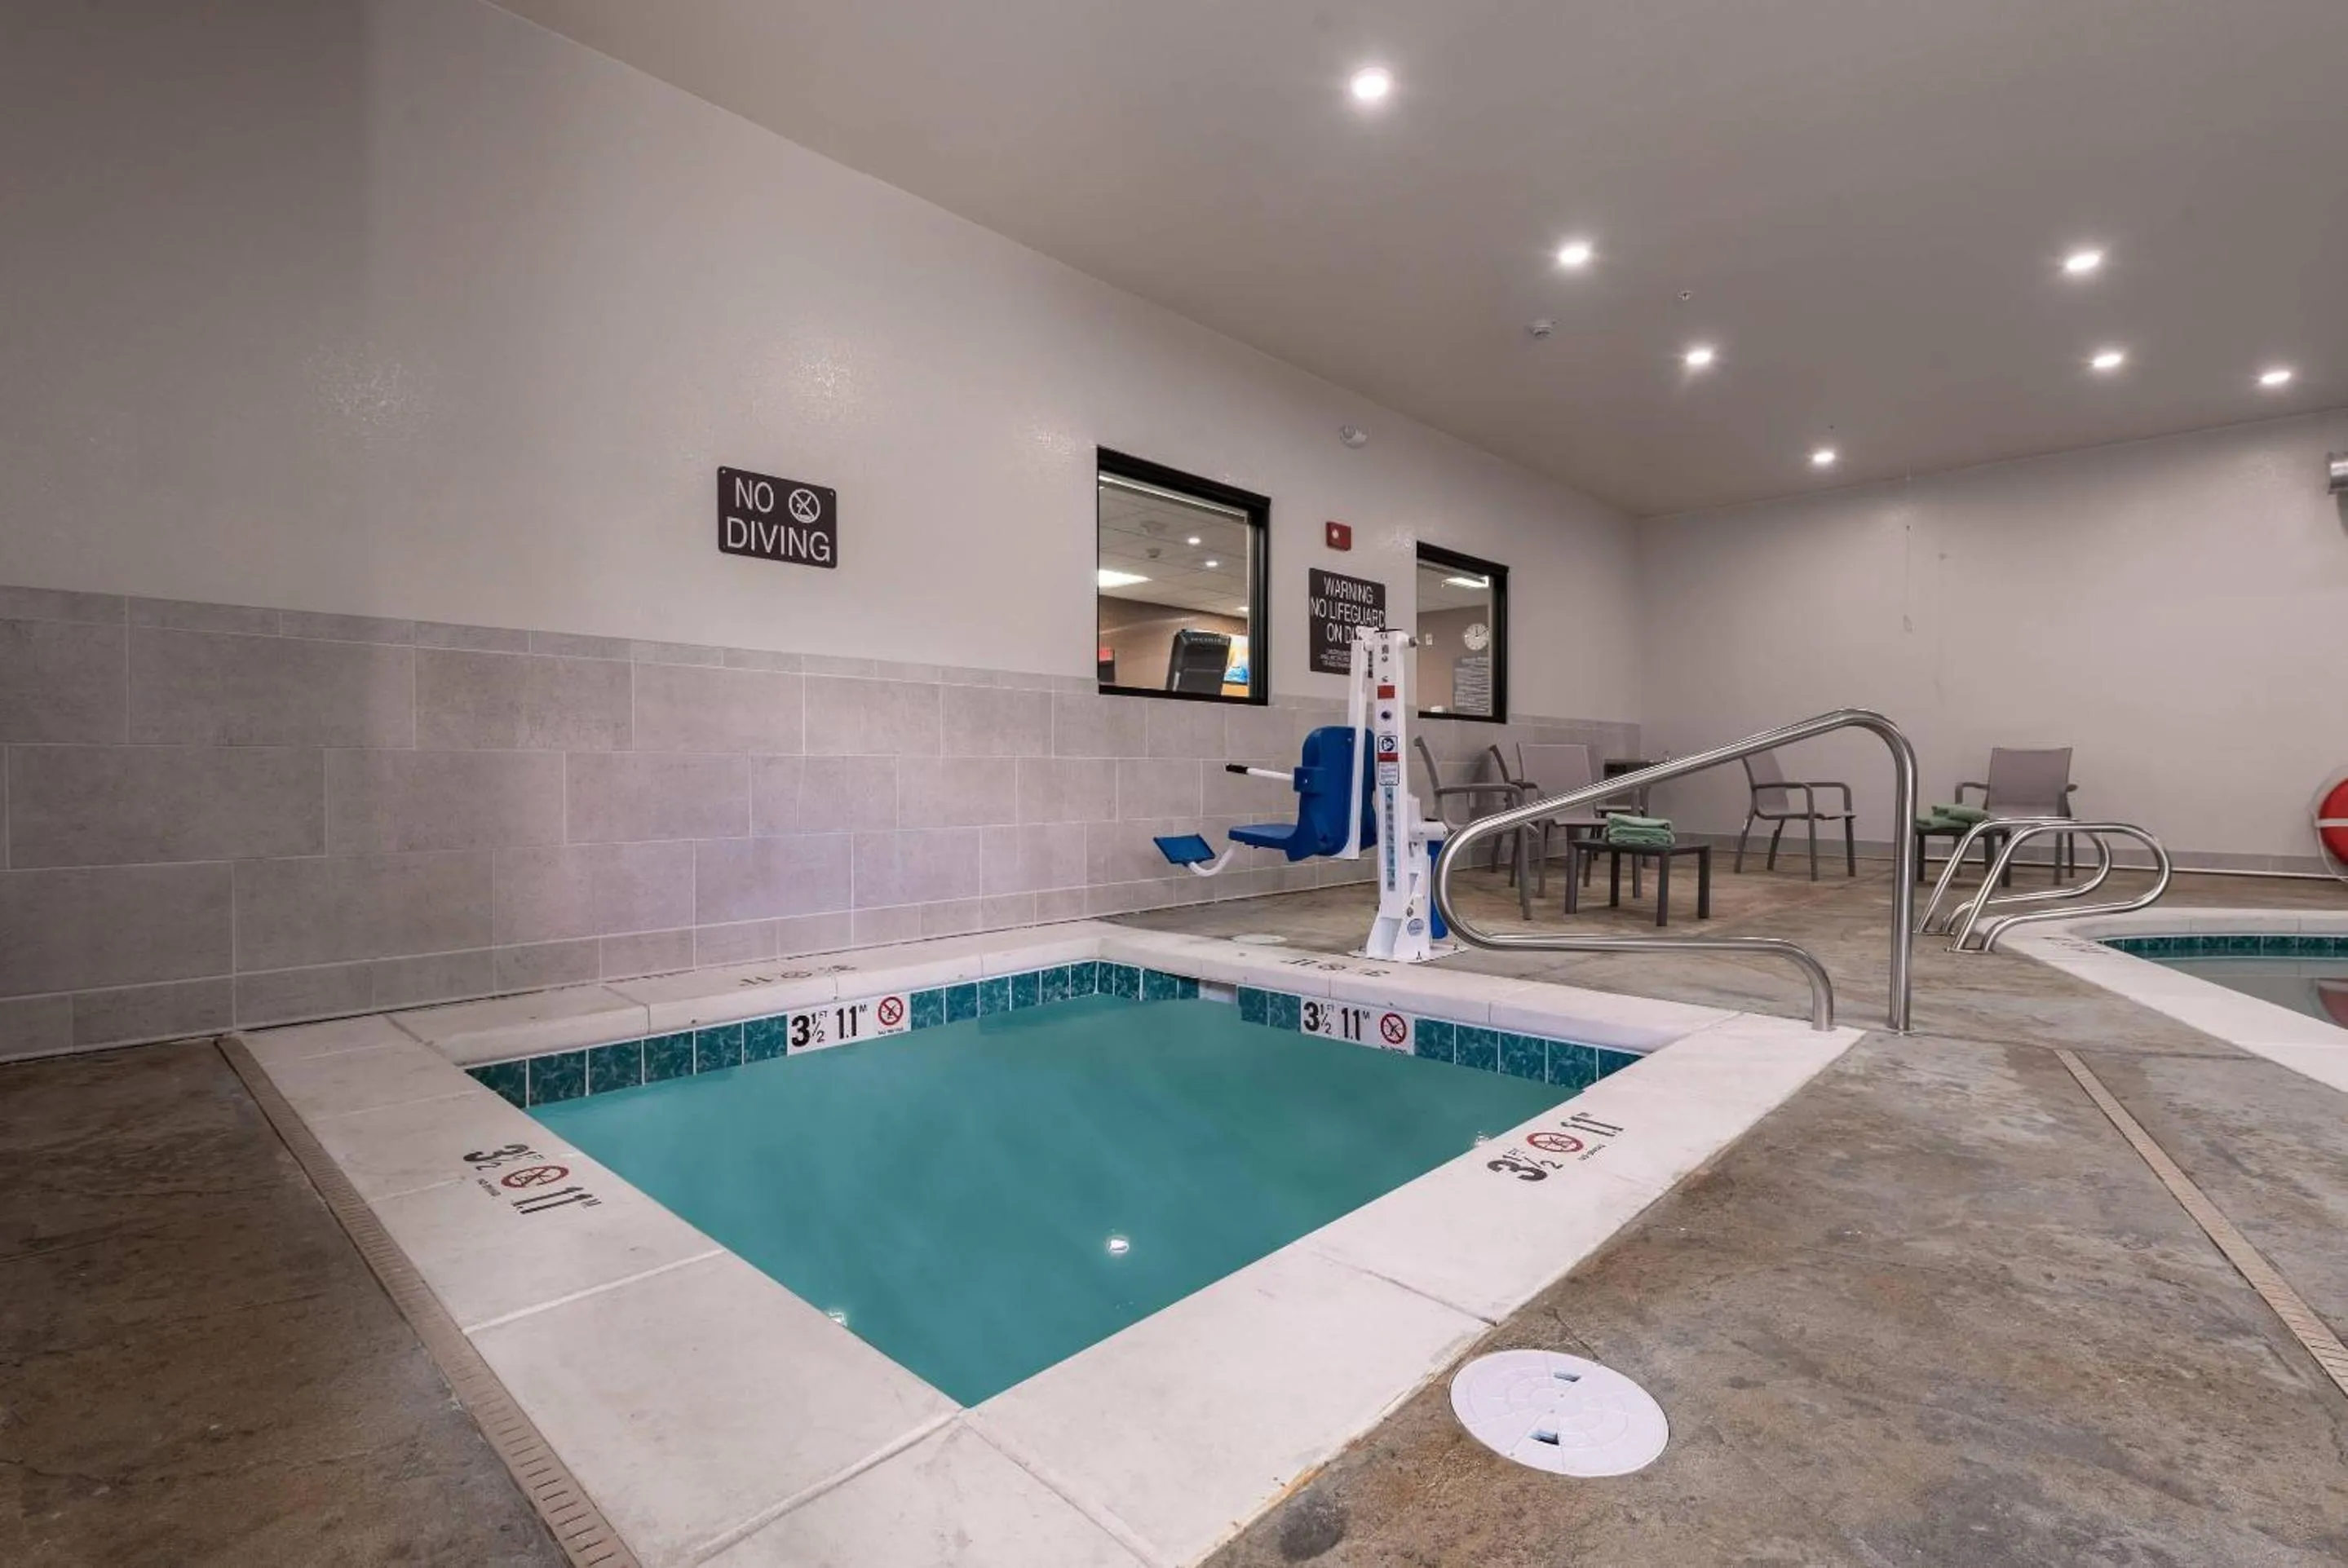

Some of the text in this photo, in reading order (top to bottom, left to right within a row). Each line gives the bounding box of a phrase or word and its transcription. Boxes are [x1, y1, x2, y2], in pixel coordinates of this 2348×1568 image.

[735, 477, 774, 513] NO
[727, 516, 830, 563] DIVING
[1324, 576, 1373, 604] WARNING
[1311, 596, 1386, 628] NO LIFEGUARD
[1327, 622, 1342, 643] ON
